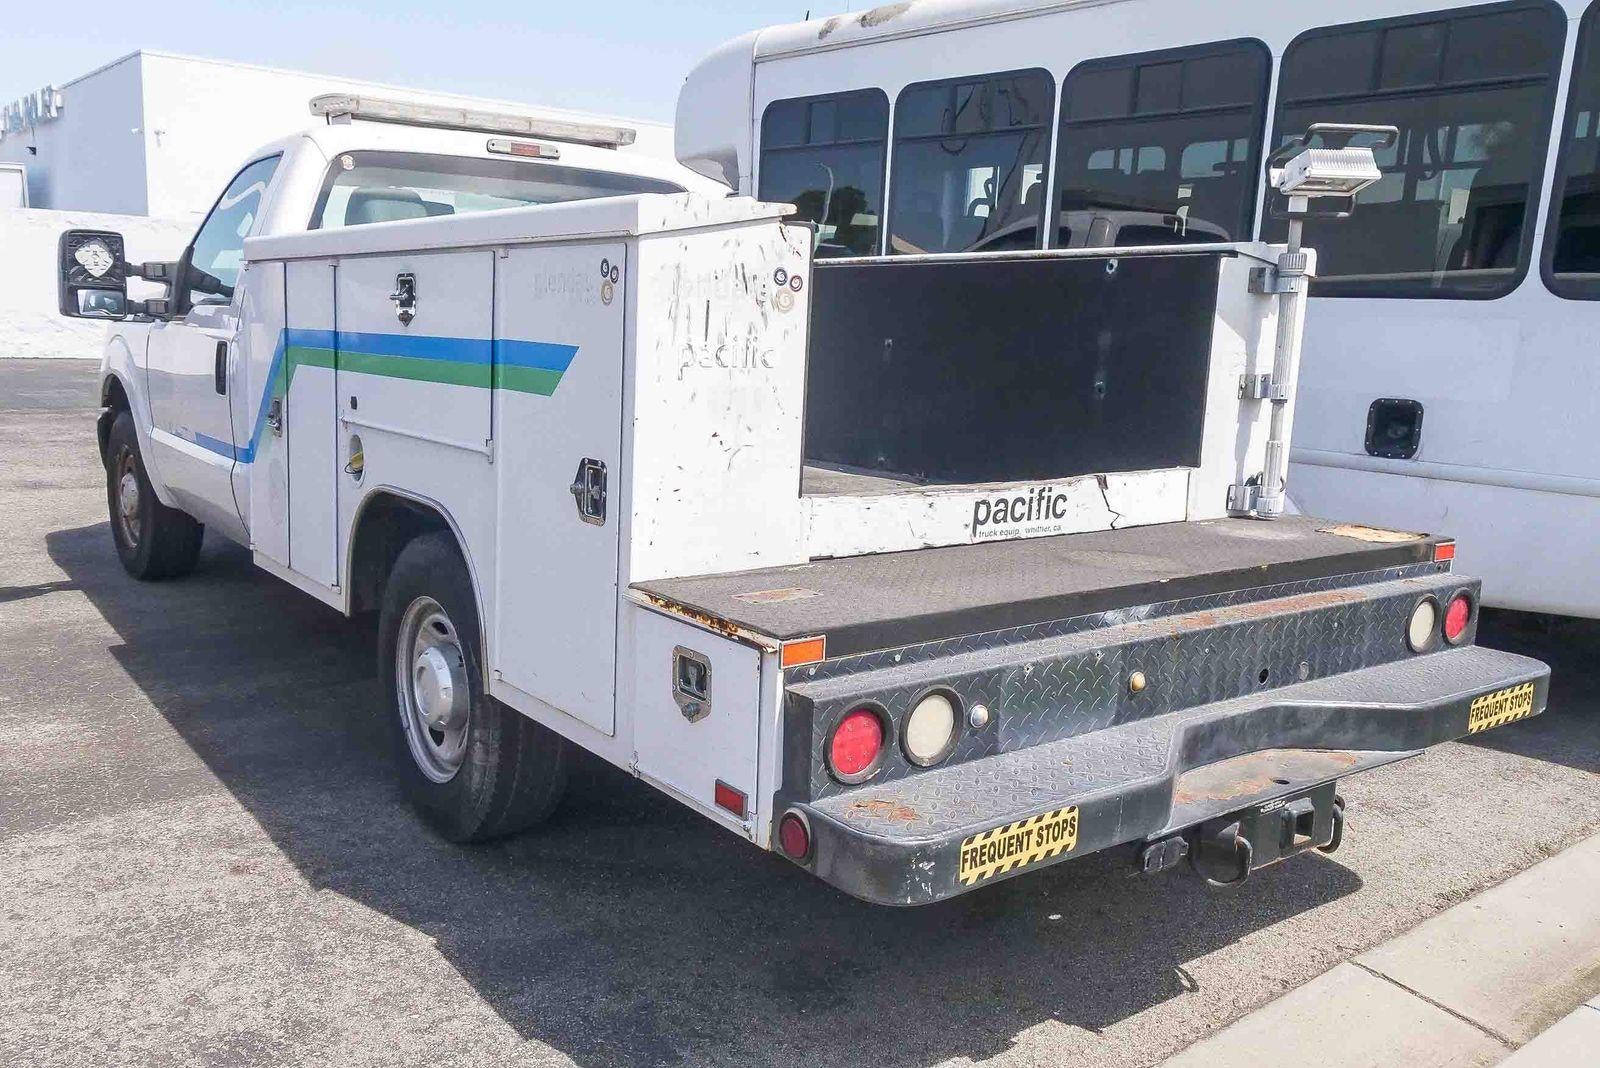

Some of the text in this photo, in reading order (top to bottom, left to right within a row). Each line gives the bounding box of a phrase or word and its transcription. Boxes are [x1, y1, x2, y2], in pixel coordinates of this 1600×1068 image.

[972, 486, 1068, 538] pacific
[978, 529, 998, 538] truck
[1470, 690, 1532, 724] FREQUENT STOPS
[961, 815, 1077, 873] FREQUENT STOPS
